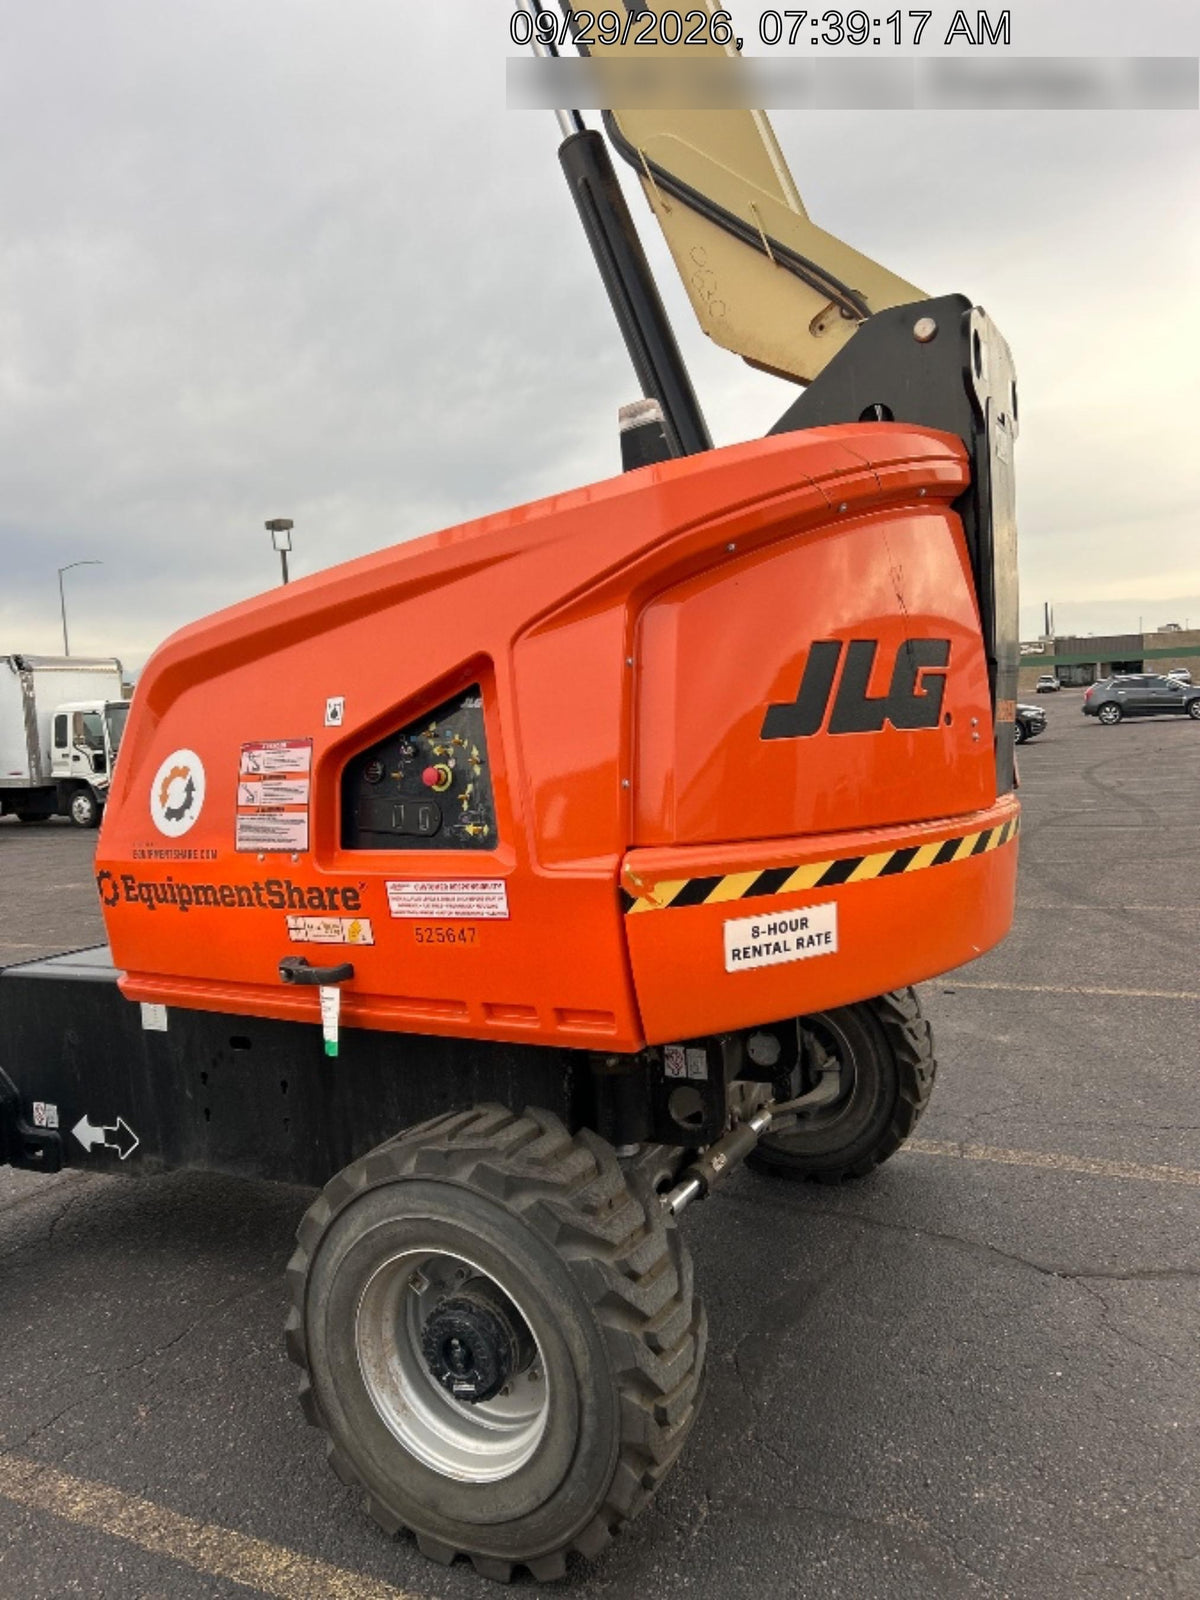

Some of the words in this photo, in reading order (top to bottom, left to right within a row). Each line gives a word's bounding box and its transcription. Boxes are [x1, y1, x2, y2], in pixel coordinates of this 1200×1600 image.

[760, 638, 951, 740] JLG
[120, 874, 362, 912] EquipmentShare
[415, 927, 476, 943] 525647
[751, 917, 809, 939] 8-HOUR
[731, 940, 791, 961] RENTAL
[795, 931, 832, 951] RATE
